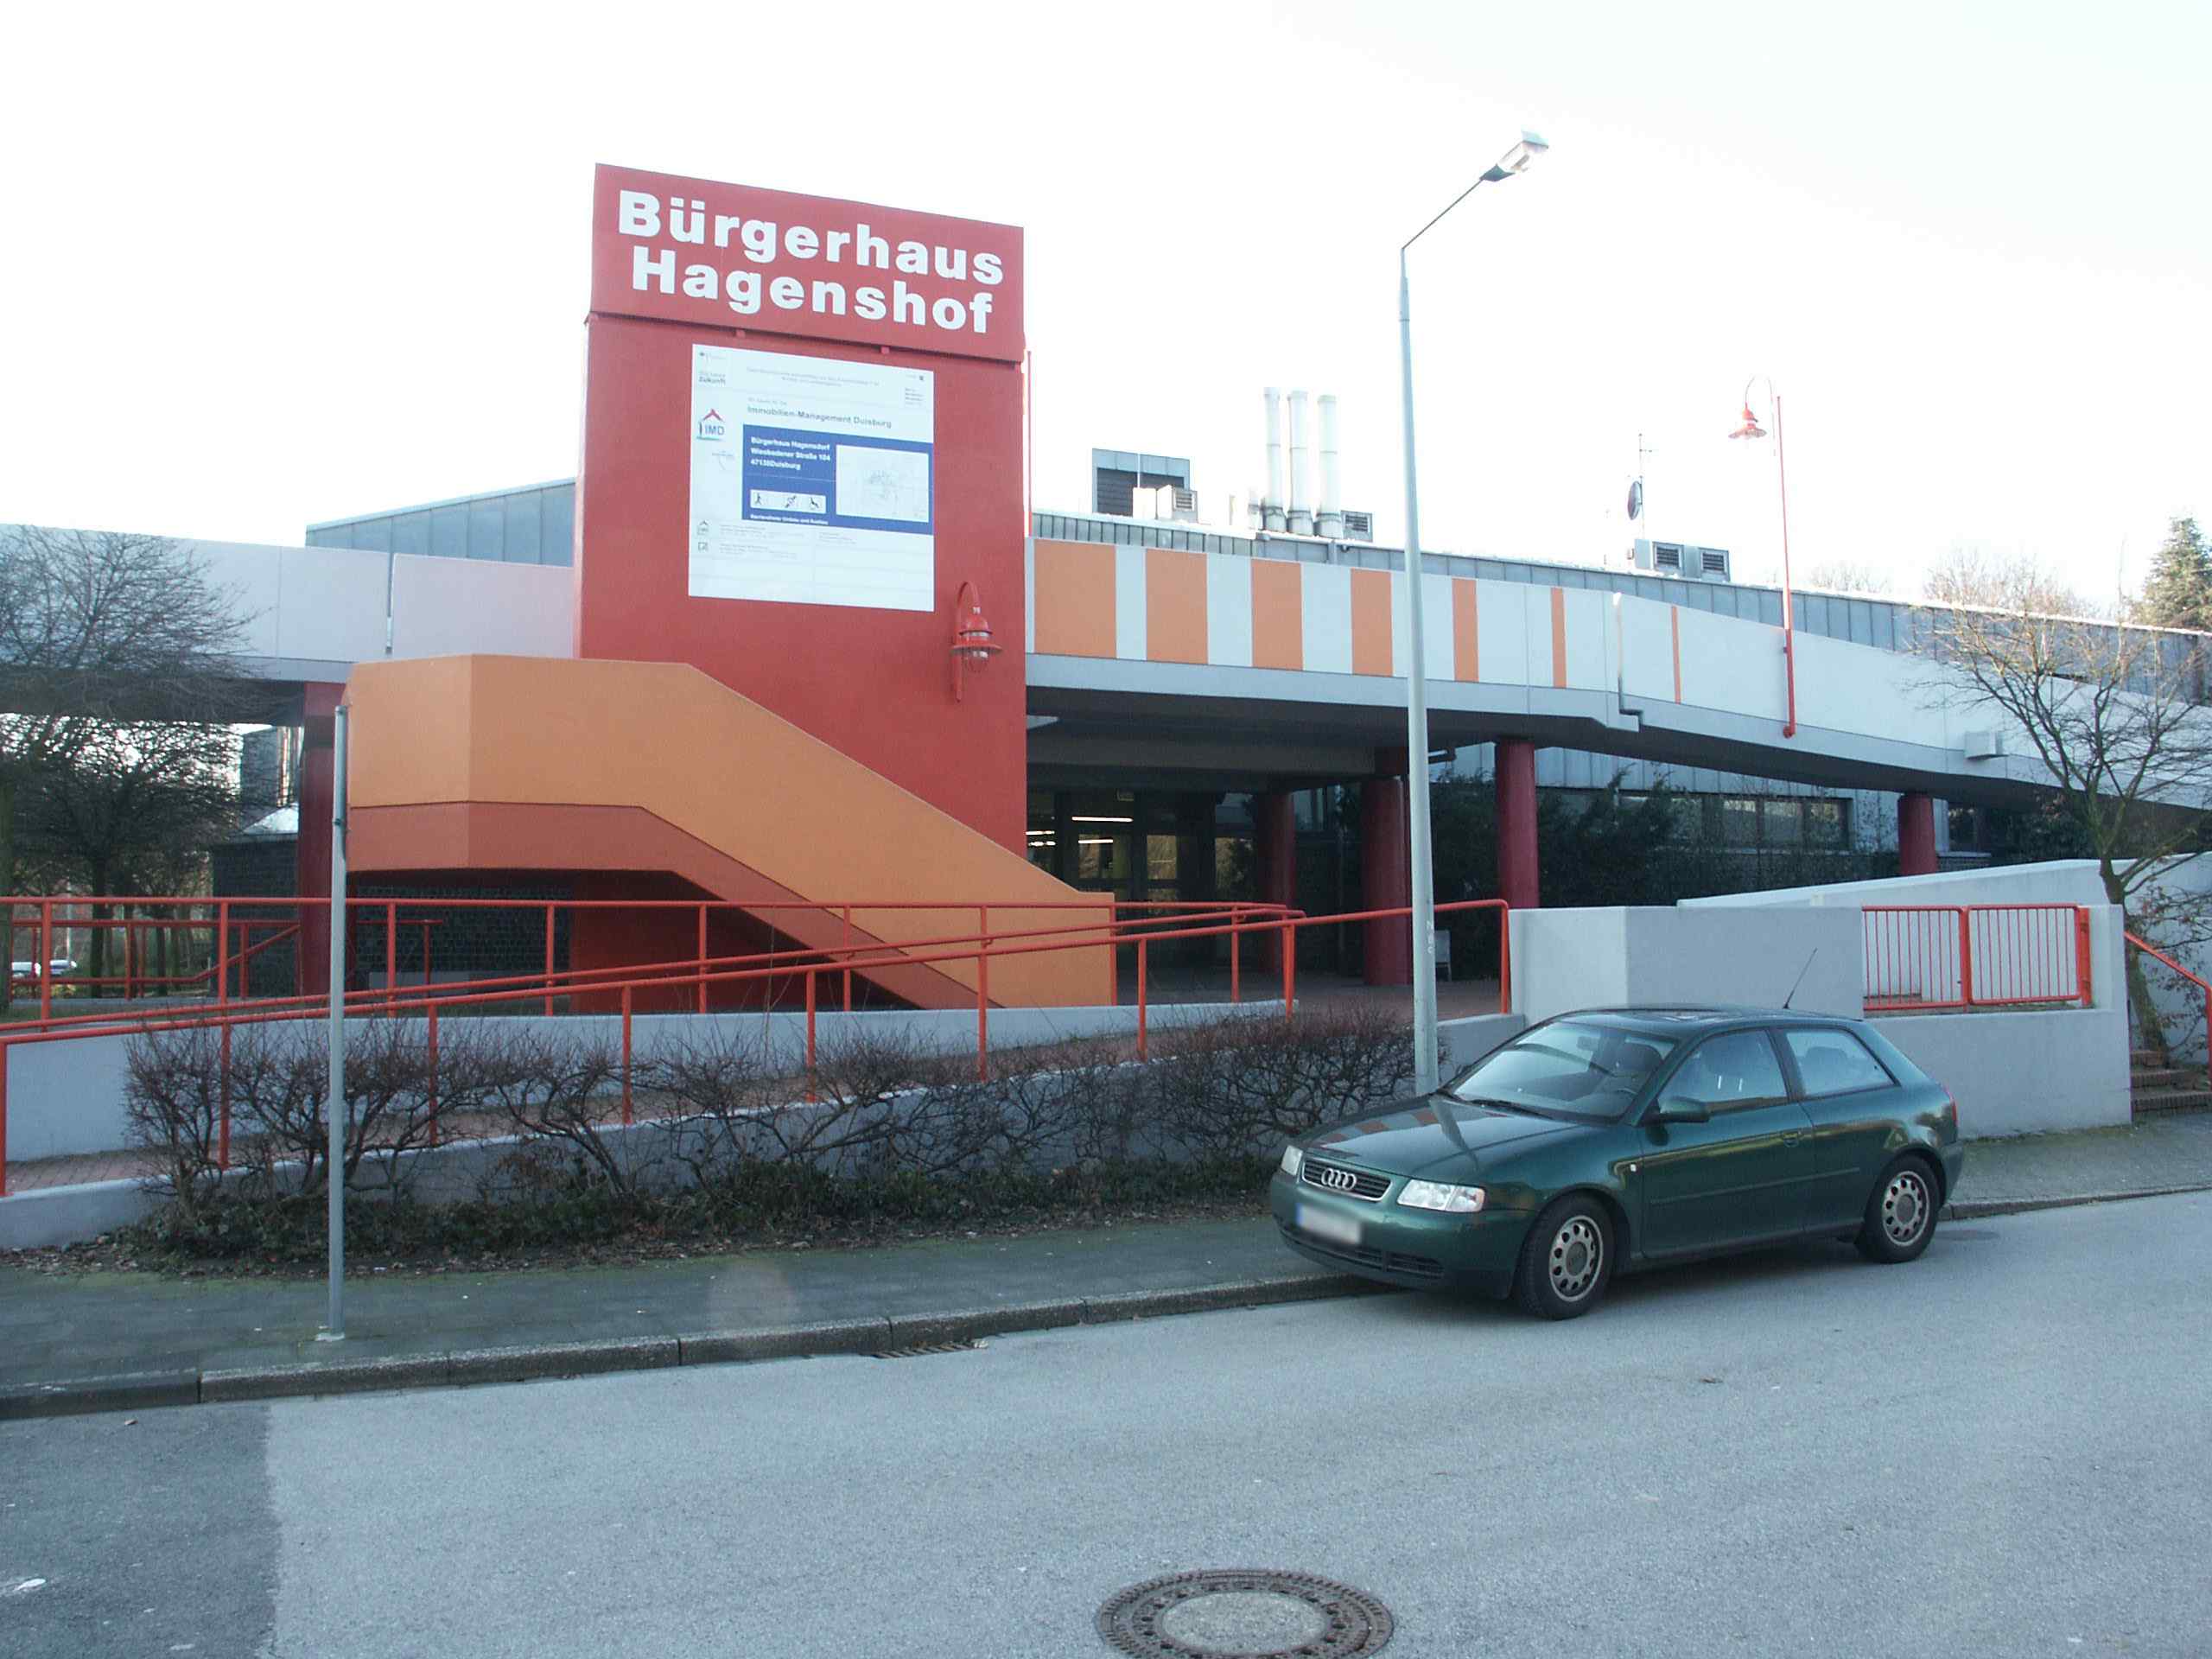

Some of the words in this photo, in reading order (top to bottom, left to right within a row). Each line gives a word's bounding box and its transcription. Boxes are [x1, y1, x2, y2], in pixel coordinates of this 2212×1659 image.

[619, 189, 1003, 285] Bürgerhaus
[632, 245, 993, 334] Hagenshof
[747, 405, 851, 423] Immobilien-Management
[853, 416, 892, 429] Duisburg
